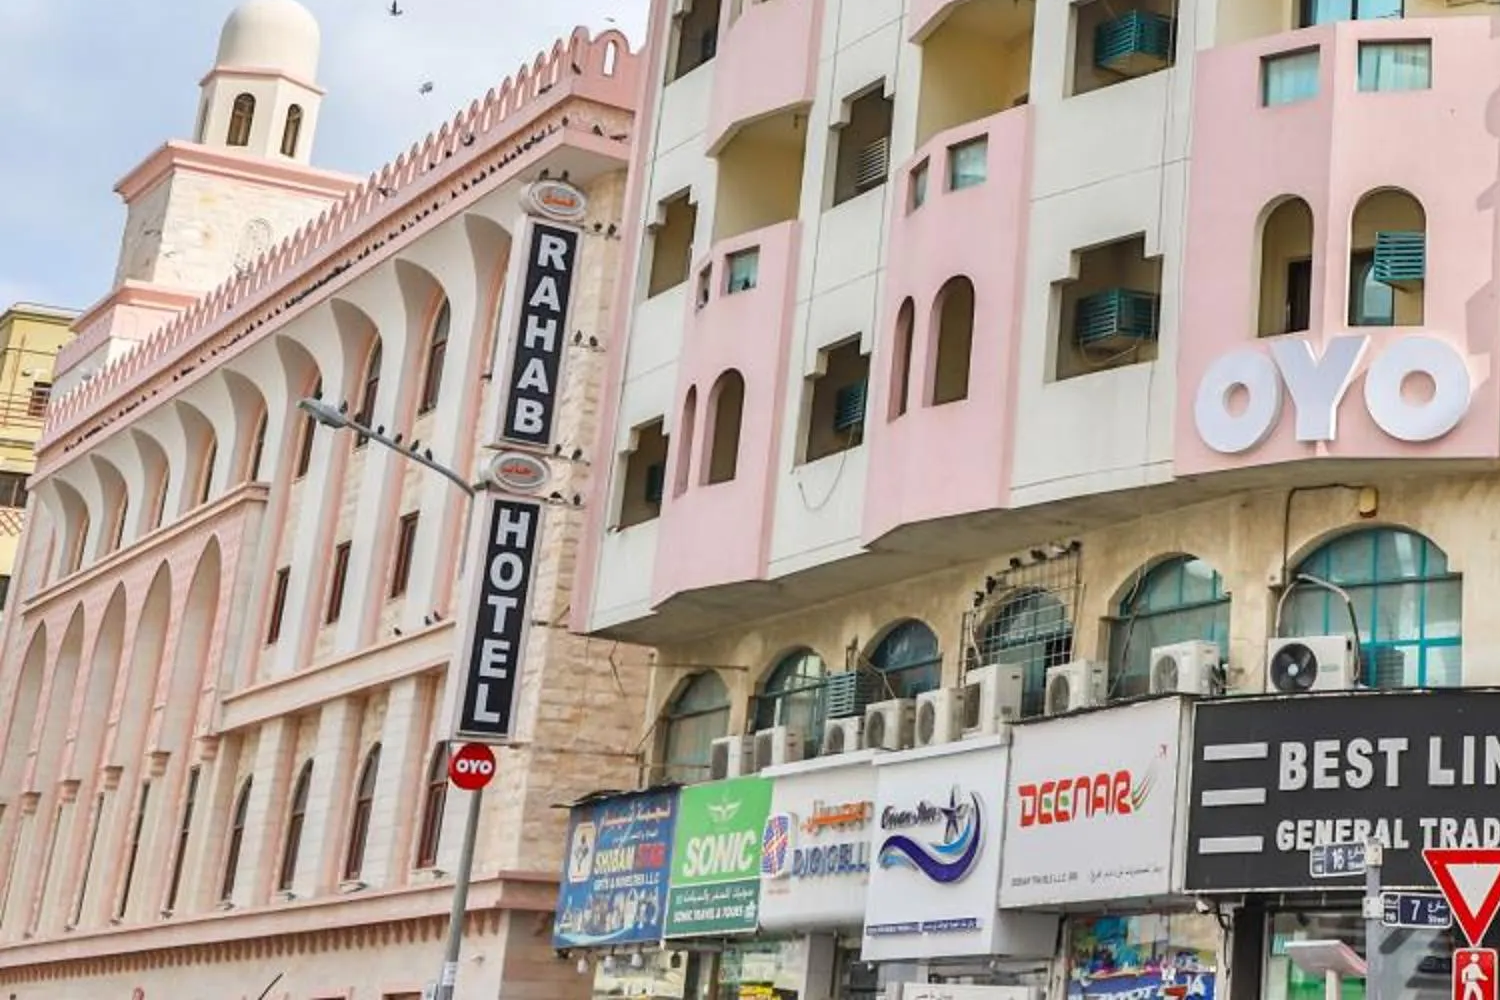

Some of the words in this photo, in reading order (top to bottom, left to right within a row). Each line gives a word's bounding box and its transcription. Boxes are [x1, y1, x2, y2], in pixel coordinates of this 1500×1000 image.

[513, 234, 568, 434] RAHAB
[1194, 333, 1471, 453] OYO
[474, 507, 530, 724] HOTEL
[455, 760, 493, 775] OYO
[1278, 737, 1409, 791] BEST
[1017, 769, 1132, 828] DEENAR
[683, 829, 757, 878] SONIC
[1275, 817, 1410, 851] GENERAL
[1411, 899, 1421, 922] 7
